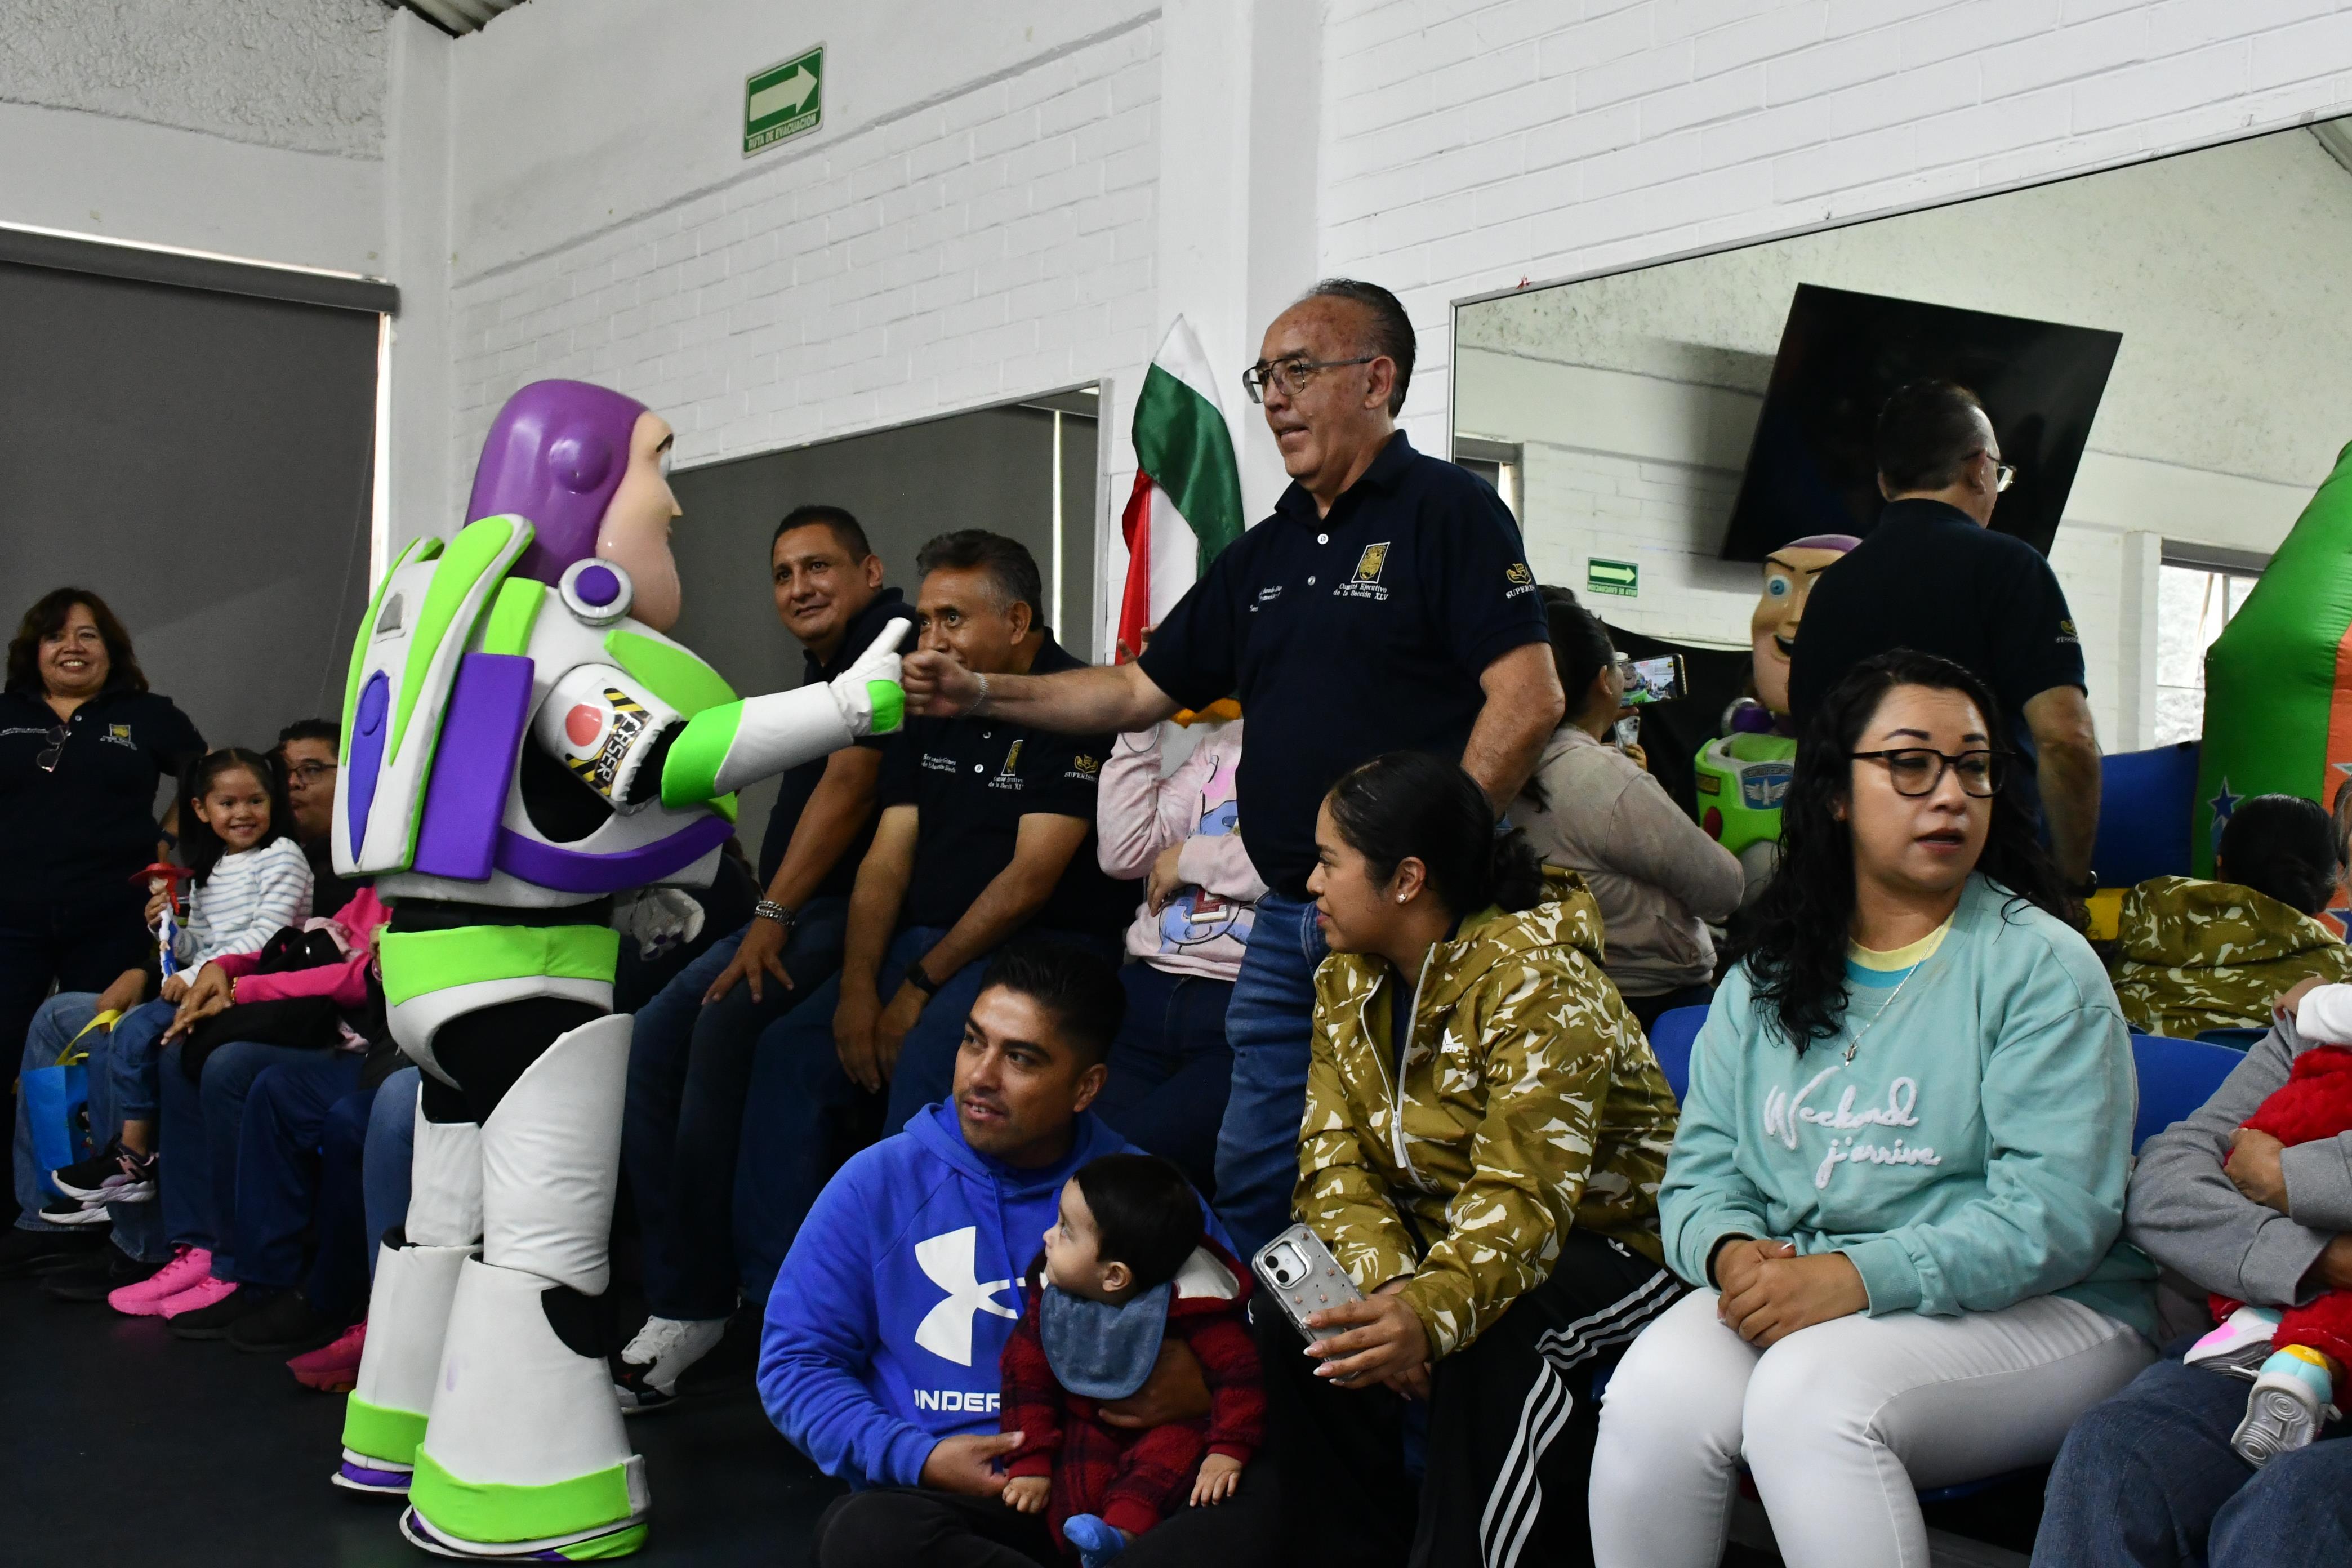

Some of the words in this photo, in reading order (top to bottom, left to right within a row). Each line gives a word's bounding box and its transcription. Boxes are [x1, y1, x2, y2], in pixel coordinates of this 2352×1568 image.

[765, 130, 774, 143] DE
[1359, 583, 1387, 593] Ejecutivo
[1374, 593, 1389, 601] XLV
